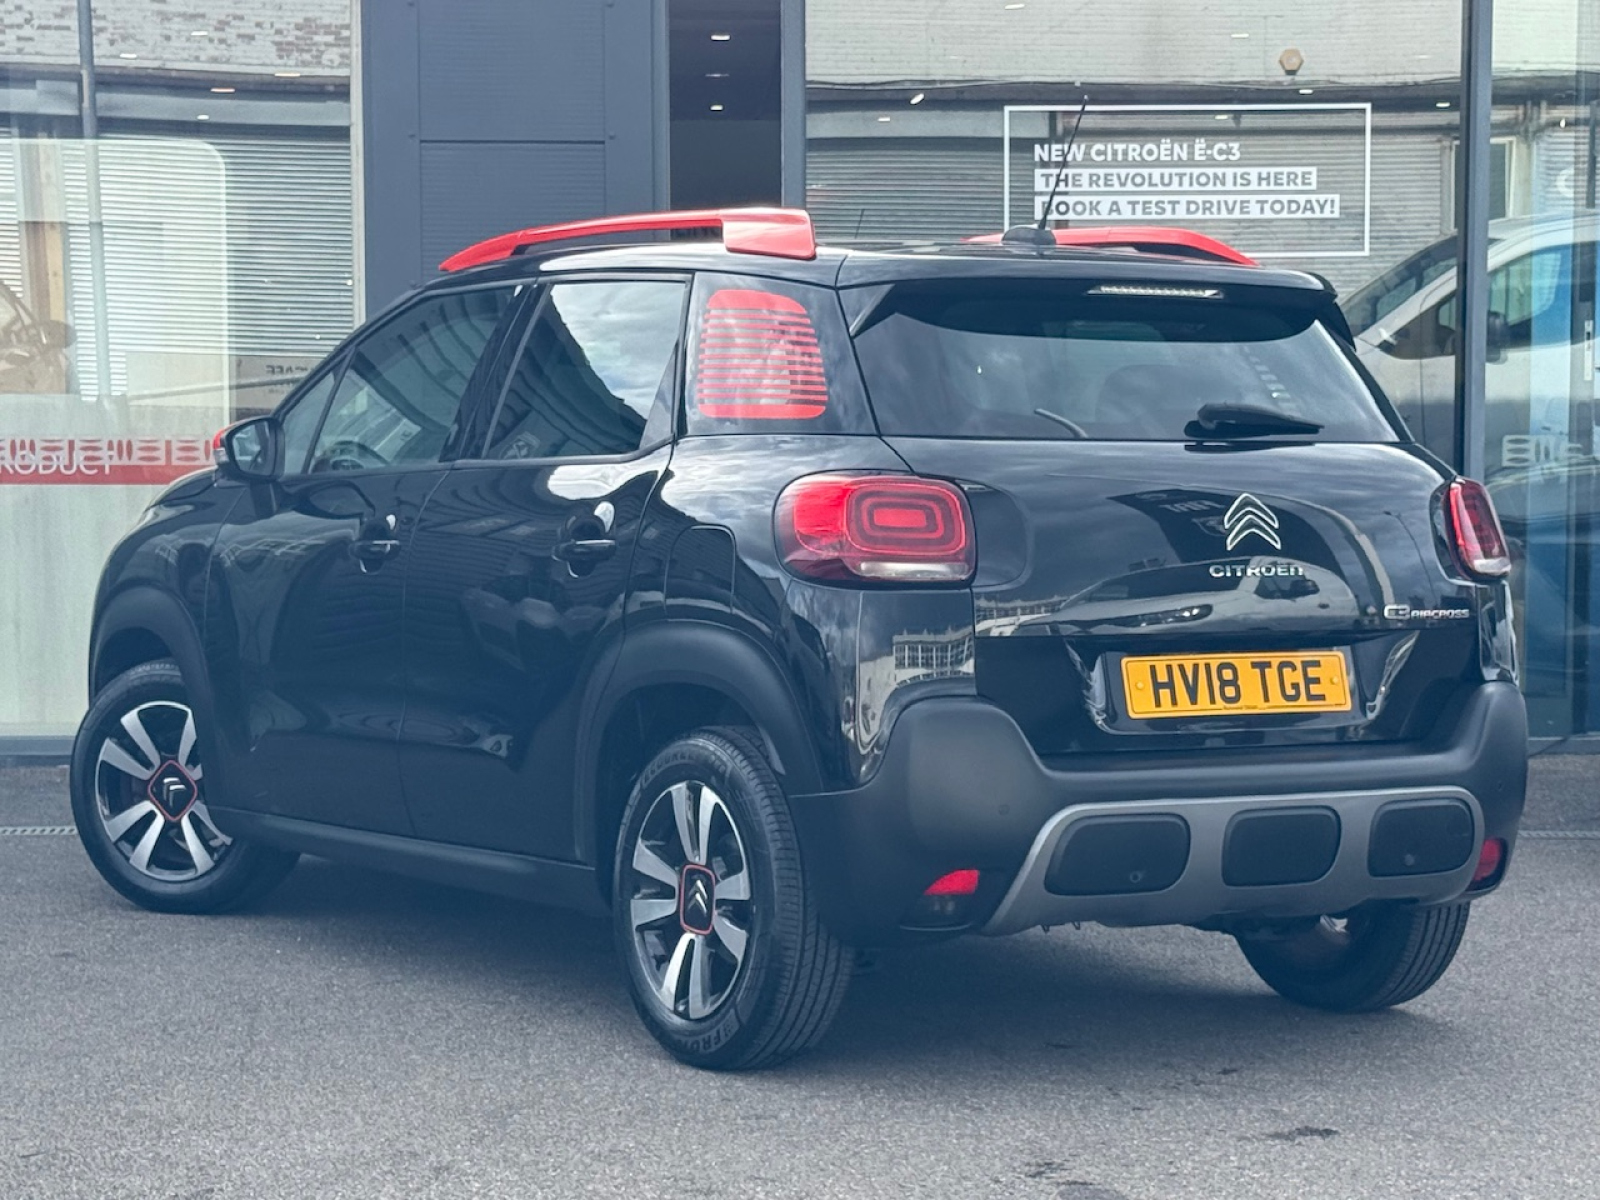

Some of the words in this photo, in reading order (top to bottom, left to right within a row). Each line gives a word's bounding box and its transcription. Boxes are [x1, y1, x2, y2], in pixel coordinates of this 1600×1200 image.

[1034, 144, 1085, 162] NEW
[1090, 138, 1188, 162] CITROËN
[1041, 173, 1083, 189] THE
[1088, 172, 1226, 188] REVOLUTION
[1232, 172, 1252, 187] IS
[1257, 171, 1313, 187] HERE
[1108, 200, 1122, 216] A
[1127, 200, 1180, 216] TEST
[1185, 200, 1251, 216] DRIVE
[1256, 198, 1336, 216] TODAY!
[1149, 662, 1242, 708] HV18
[1251, 660, 1326, 703] TGE
